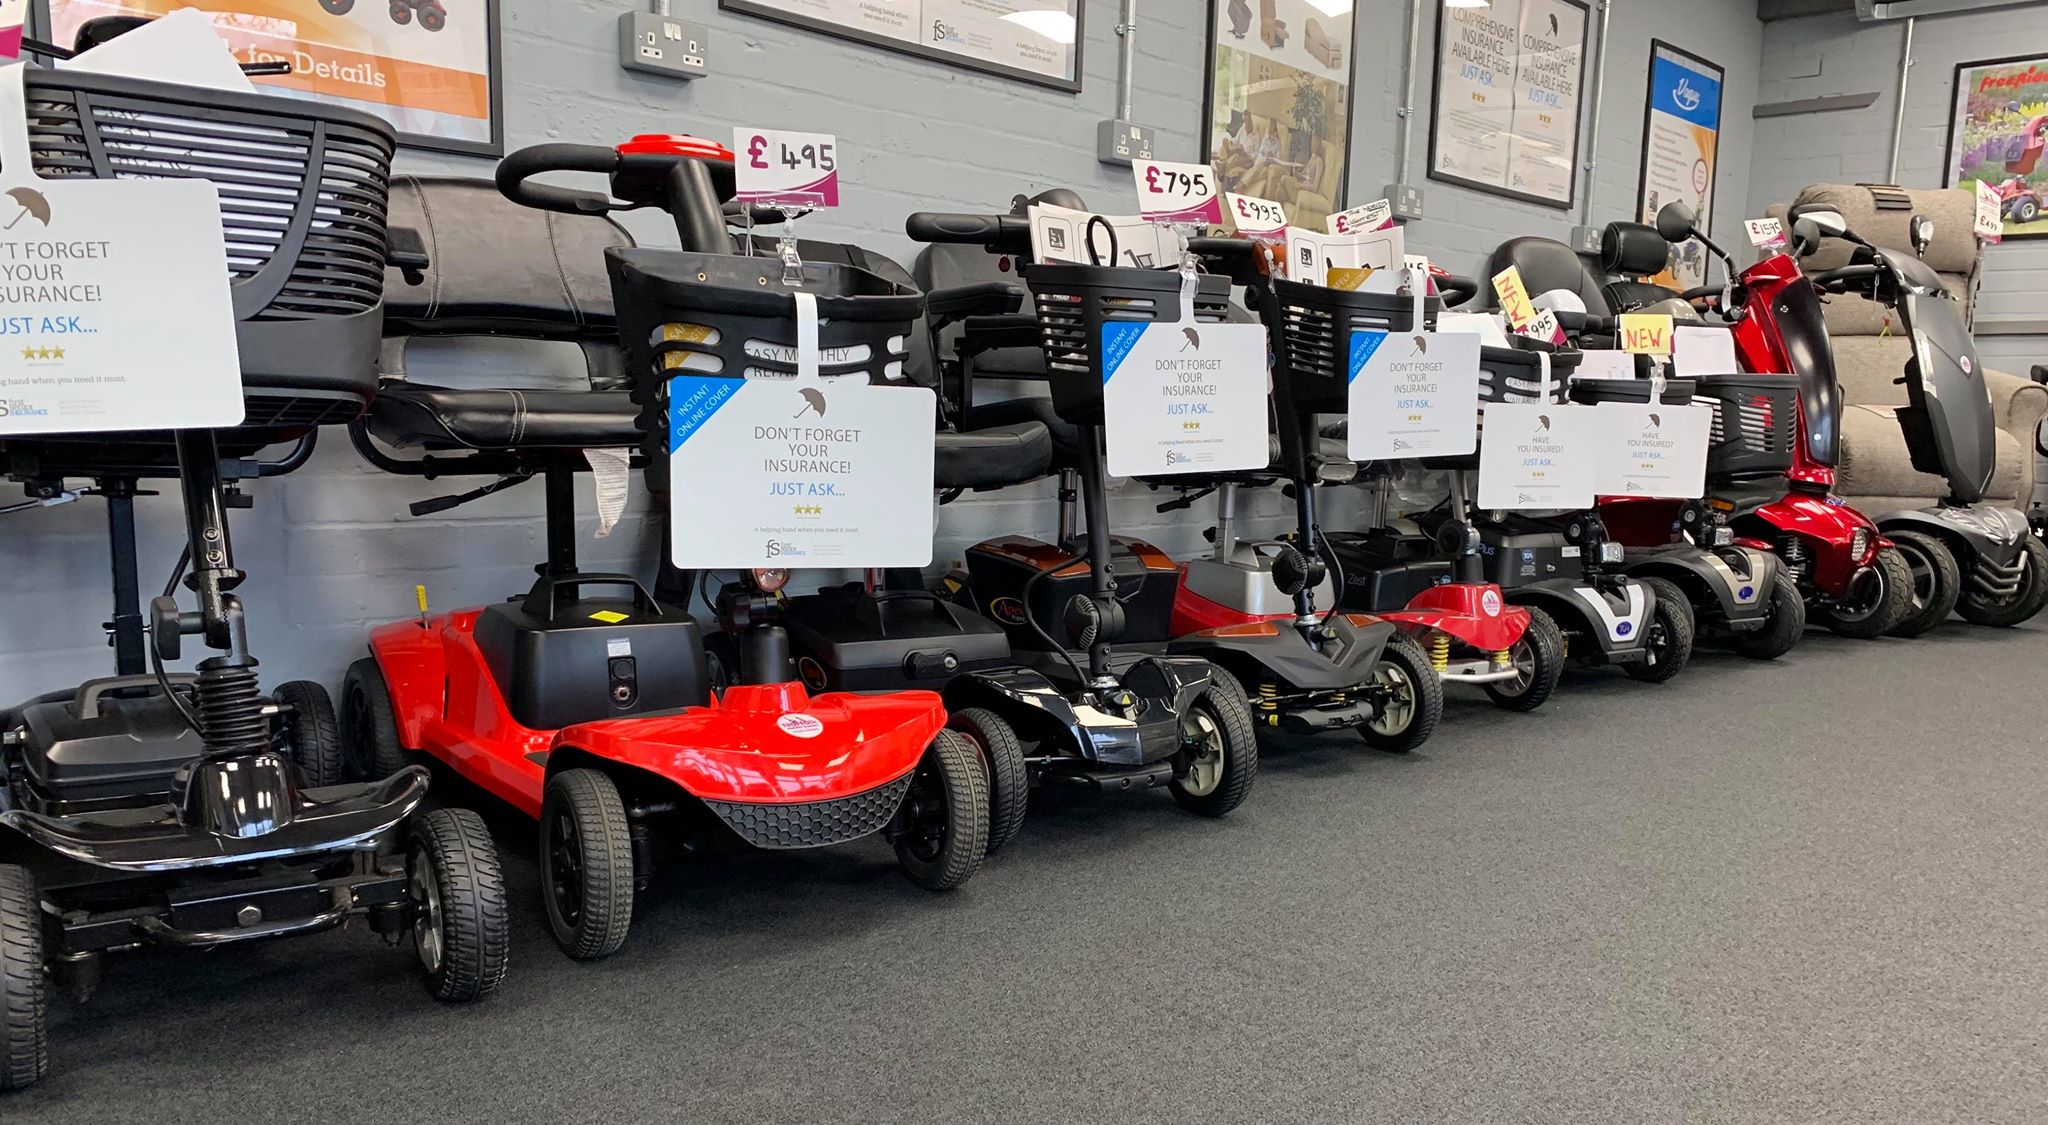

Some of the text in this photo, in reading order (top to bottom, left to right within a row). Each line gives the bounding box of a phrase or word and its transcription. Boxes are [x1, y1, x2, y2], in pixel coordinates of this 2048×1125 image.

[1453, 7, 1515, 43] COMPREHENSIVE
[1461, 27, 1504, 56] INSURANCE
[1523, 34, 1577, 66] COMPREHENSIVE
[1452, 42, 1511, 76] AVAILABLE HERE
[1531, 53, 1568, 79] INSURANCE
[293, 50, 386, 88] Details
[1460, 64, 1479, 80] JUST
[1522, 68, 1574, 97] AVAILABLE HERE
[1528, 88, 1545, 103] JUST
[781, 143, 835, 171] 495
[1145, 165, 1207, 197] £795
[1237, 198, 1282, 224] £995
[25, 241, 110, 259] FORGET
[2, 263, 64, 281] YOUR
[1497, 276, 1527, 322] NEW
[41, 316, 98, 334] ASK...
[1106, 328, 1127, 355] INSTANT
[1626, 327, 1663, 350] NEW
[784, 348, 850, 363] MTHLY
[1107, 327, 1140, 371] ONLINE COVER
[1352, 335, 1381, 373] ONLINE COVER
[1353, 337, 1370, 359] INSTANT
[1187, 359, 1222, 370] FORGET
[1415, 362, 1443, 372] FORGET
[1177, 372, 1202, 383] YOUR
[1406, 373, 1427, 383] YOUR
[1162, 385, 1216, 396] INSURANCE!
[1394, 384, 1437, 393] INSURANCE!
[677, 384, 710, 417] INSTANT
[1396, 400, 1414, 409] JUST
[676, 384, 732, 437] ONLINE COVER
[1167, 404, 1189, 415] JUST
[805, 428, 861, 442] FORGET
[1532, 436, 1550, 444] HAVE
[1642, 432, 1660, 440] HAVE
[788, 443, 828, 457] YOUR
[1517, 445, 1564, 453] YOU INSURED?
[1627, 439, 1674, 448] YOU INSURED?
[1522, 458, 1538, 466] JUST
[1632, 451, 1647, 459] JUST
[764, 459, 851, 474] INSURANCE!
[769, 482, 845, 496] JUST ASK...
[1347, 573, 1366, 586] Zest
